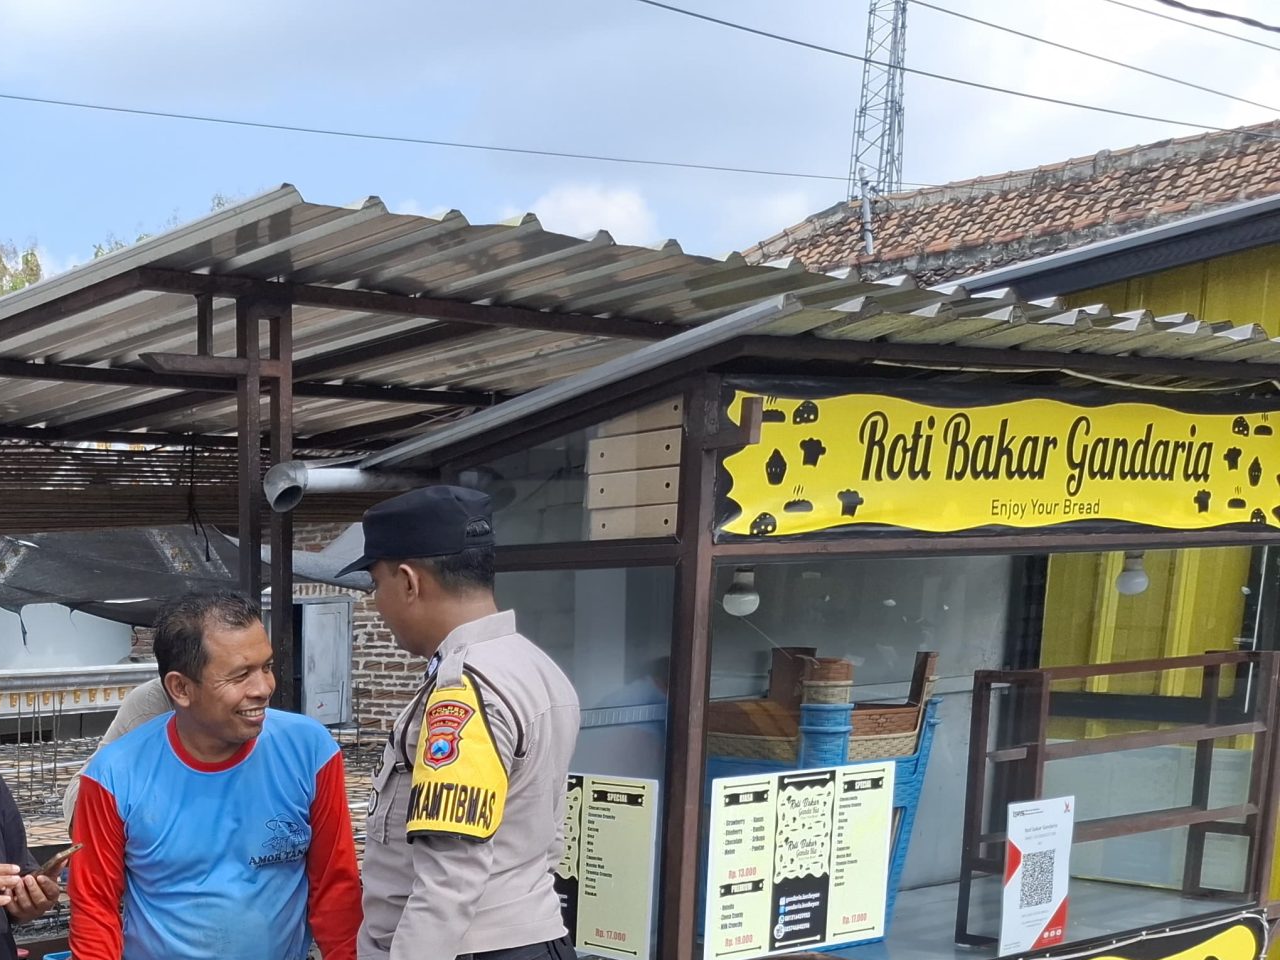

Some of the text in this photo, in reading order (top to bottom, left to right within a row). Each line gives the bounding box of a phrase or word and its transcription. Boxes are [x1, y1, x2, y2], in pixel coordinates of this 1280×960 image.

[858, 410, 1214, 497] Roti Bakar Gandaria
[991, 498, 1100, 520] Enjoy Your Bread
[595, 928, 626, 942] Rp. 17.000
